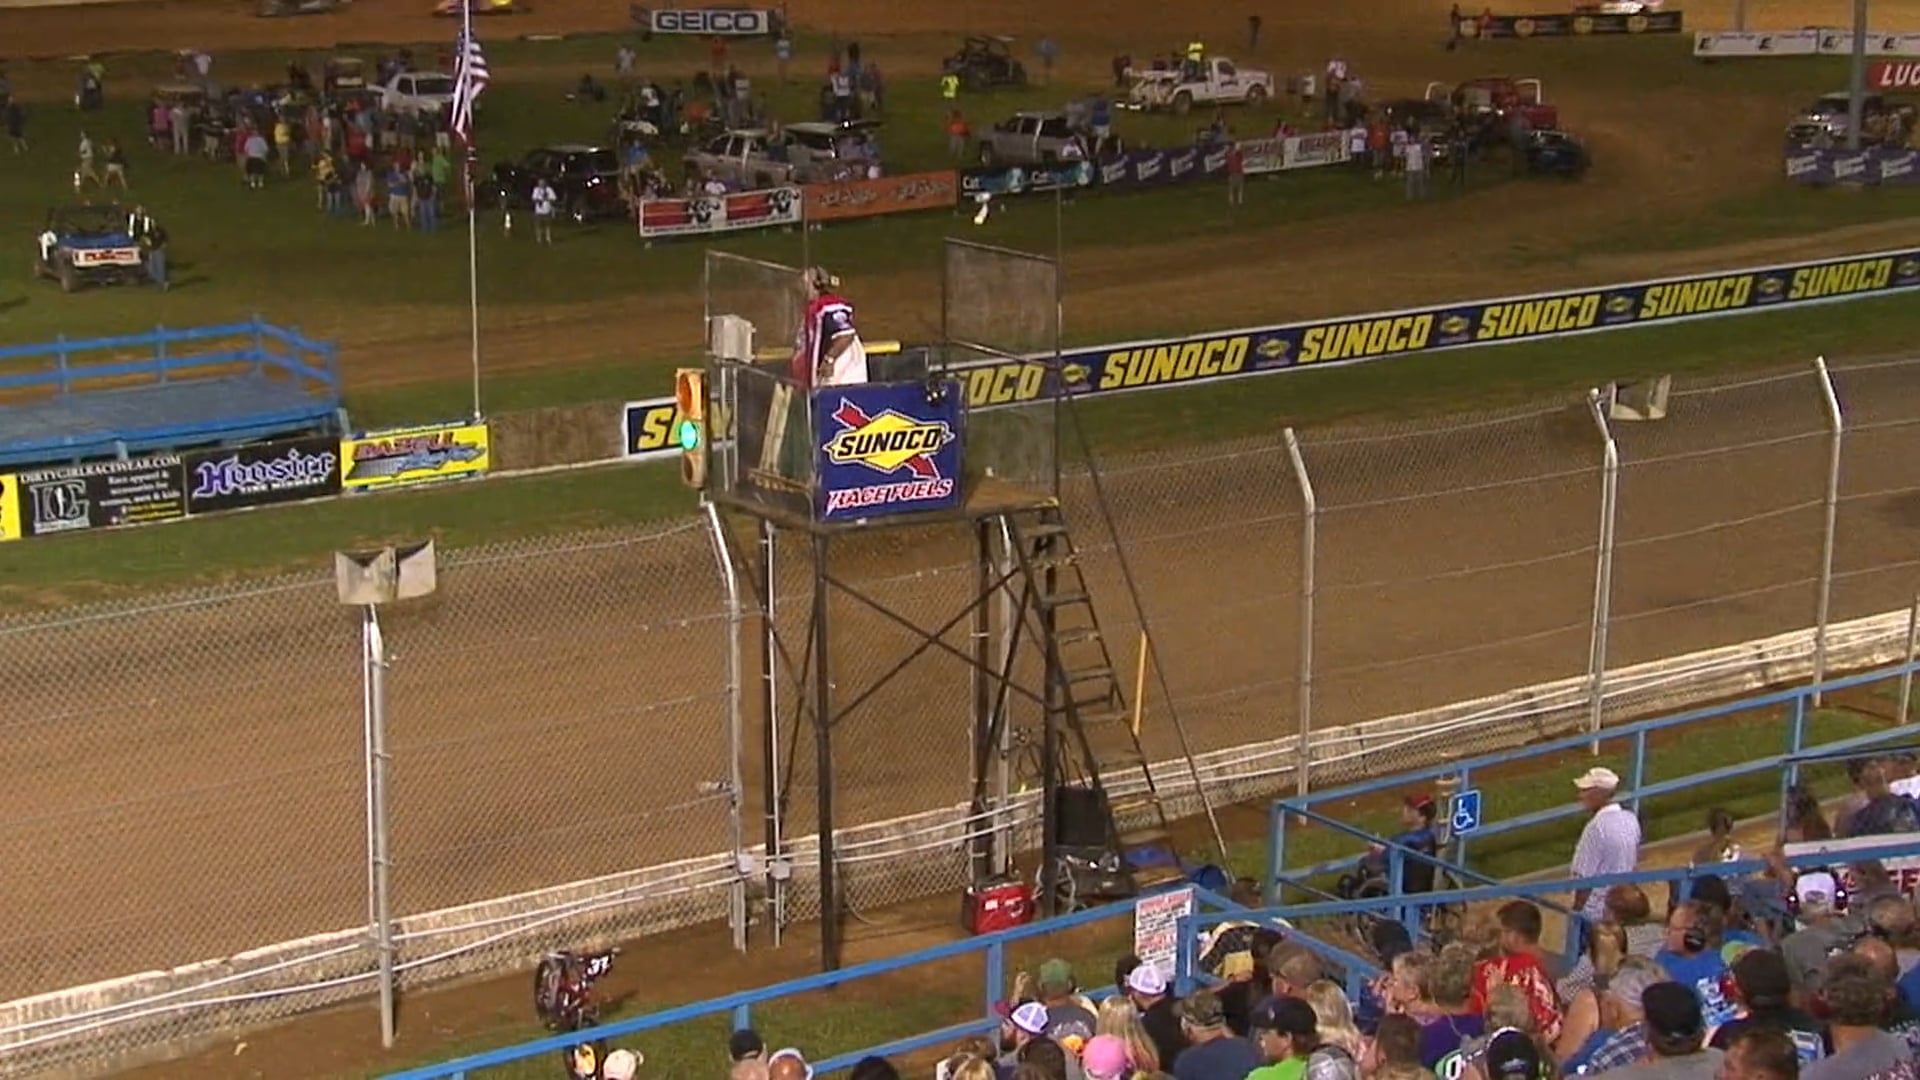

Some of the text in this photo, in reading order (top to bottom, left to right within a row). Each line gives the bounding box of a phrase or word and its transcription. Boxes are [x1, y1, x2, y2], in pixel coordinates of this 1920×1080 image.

[656, 11, 760, 31] GEICO
[1638, 275, 1754, 319] SUNOCO
[1788, 258, 1893, 299] SUNOCO
[1477, 293, 1602, 340] SUNOCO
[1297, 314, 1434, 363] SUNOCO
[1100, 336, 1250, 388] SUNOCO
[959, 364, 1046, 406] OCO
[838, 424, 943, 457] SUNOCO
[191, 447, 337, 499] Hoosier
[826, 479, 953, 515] RACE FUELS
[587, 955, 610, 976] 37
